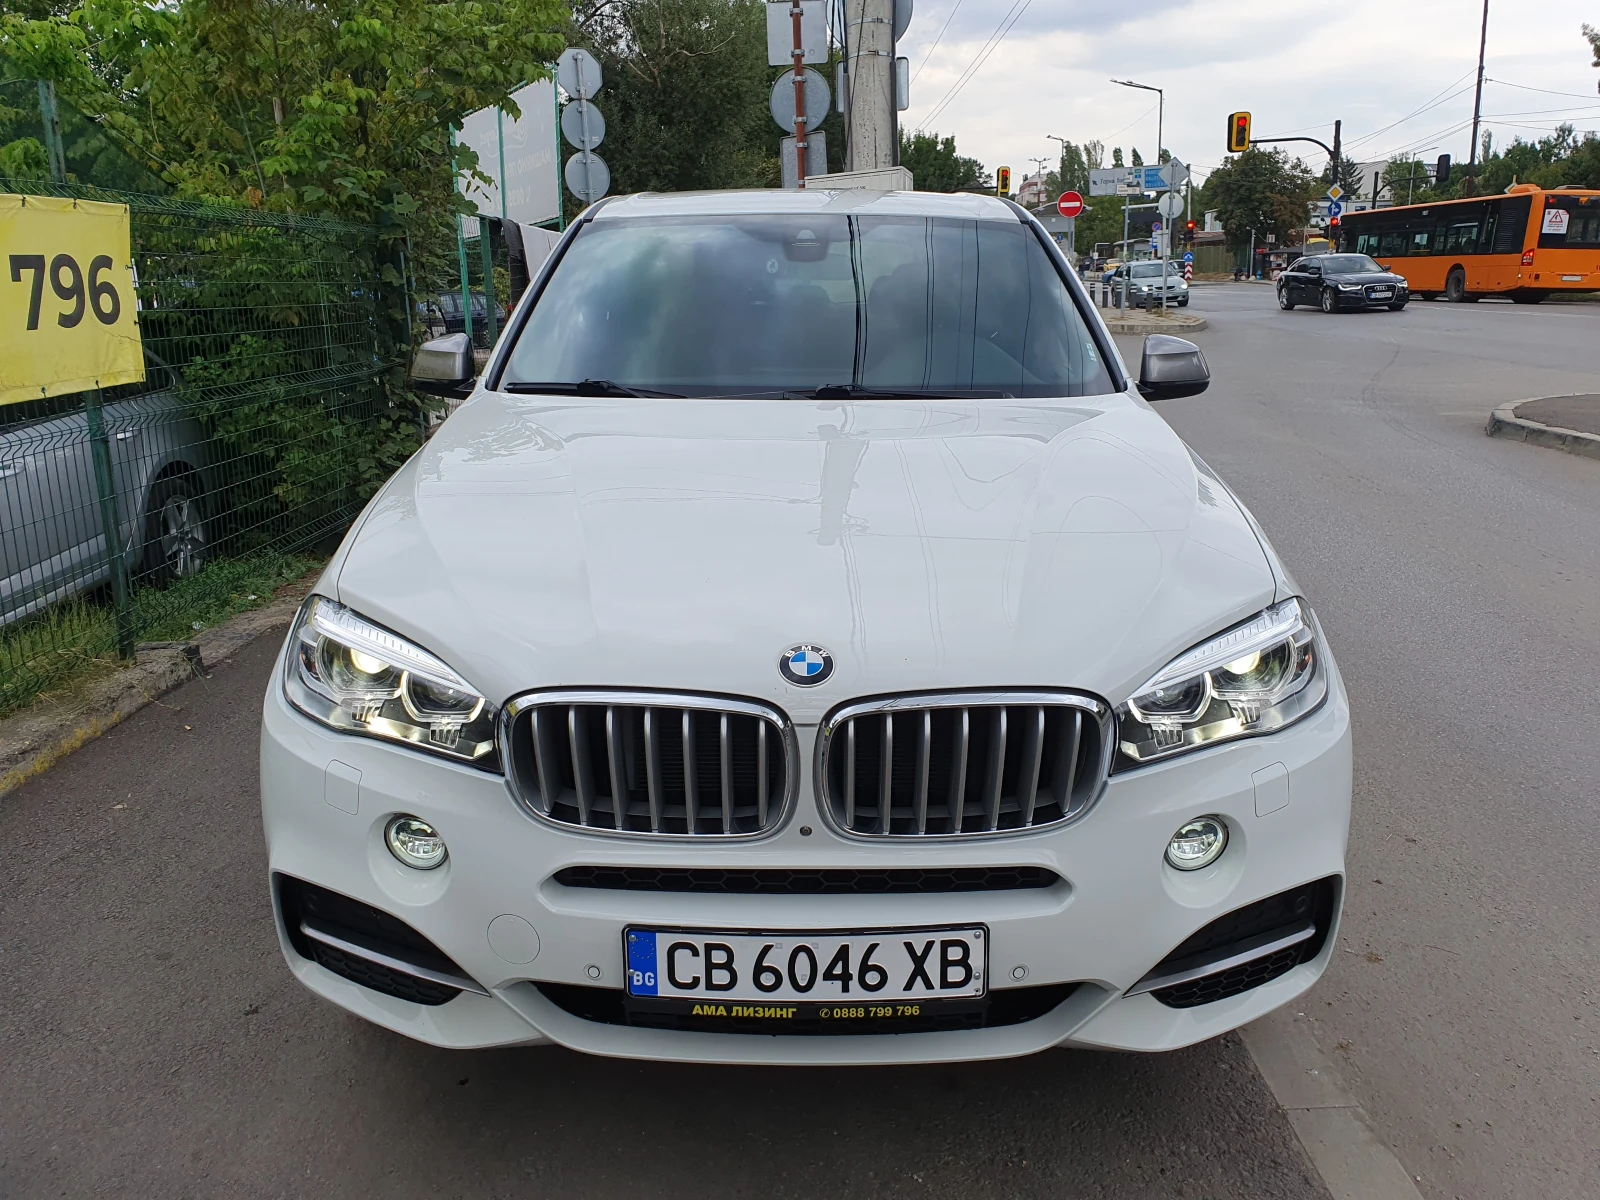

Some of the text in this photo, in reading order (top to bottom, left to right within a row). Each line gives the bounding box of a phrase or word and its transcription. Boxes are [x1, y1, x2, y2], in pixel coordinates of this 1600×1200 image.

[9, 253, 121, 330] 796
[784, 645, 830, 657] BMW
[666, 938, 973, 994] CB 6046 XB
[633, 972, 655, 987] BG
[692, 1005, 797, 1019] АМА ЛИЗИНГ
[833, 1005, 920, 1019] 0888 799 796
